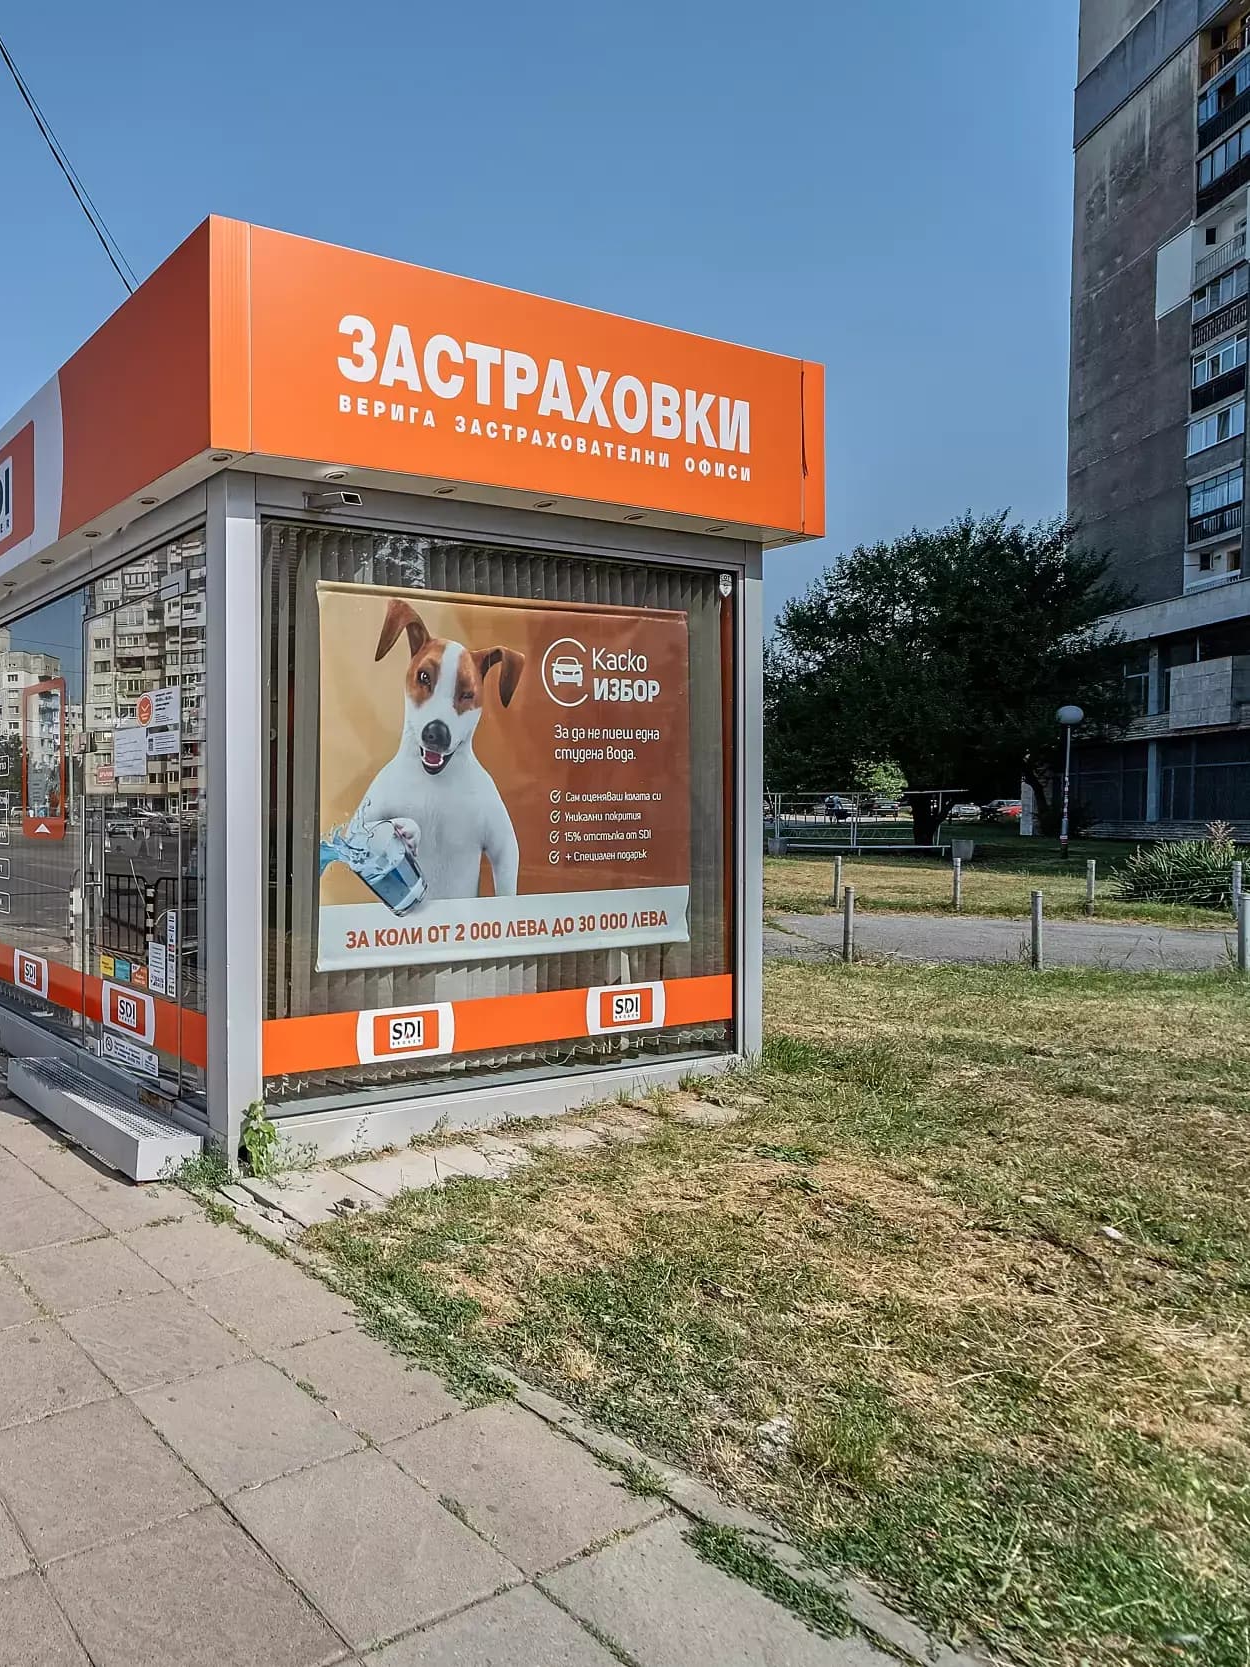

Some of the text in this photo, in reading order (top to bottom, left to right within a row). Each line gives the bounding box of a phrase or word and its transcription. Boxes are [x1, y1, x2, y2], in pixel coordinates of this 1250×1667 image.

[337, 314, 750, 454] ЗАСТРАХОВКИ
[338, 394, 751, 482] ВЕРИГА ЗАСТРАХОВАТЕЛНИ ОФИСИ
[592, 647, 647, 673] Каско
[593, 677, 661, 703] ИЗБОР
[554, 724, 660, 743] За да не пиеш една
[554, 745, 637, 763] студена вода.
[565, 791, 662, 803] Сам оценяваш колата си
[564, 811, 642, 823] Уникални покрития
[564, 829, 652, 842] 15% отстъпка от SDI
[573, 851, 616, 863] Специален
[616, 848, 648, 862] подарък
[346, 910, 668, 949] ЗА КОЛИ ОТ 2 000 ЛЕВА ДО 30 000 ЛЕВА
[25, 963, 36, 979] SDI
[119, 999, 136, 1020] SDI
[615, 996, 639, 1015] SDI
[392, 1020, 421, 1041] SDI
